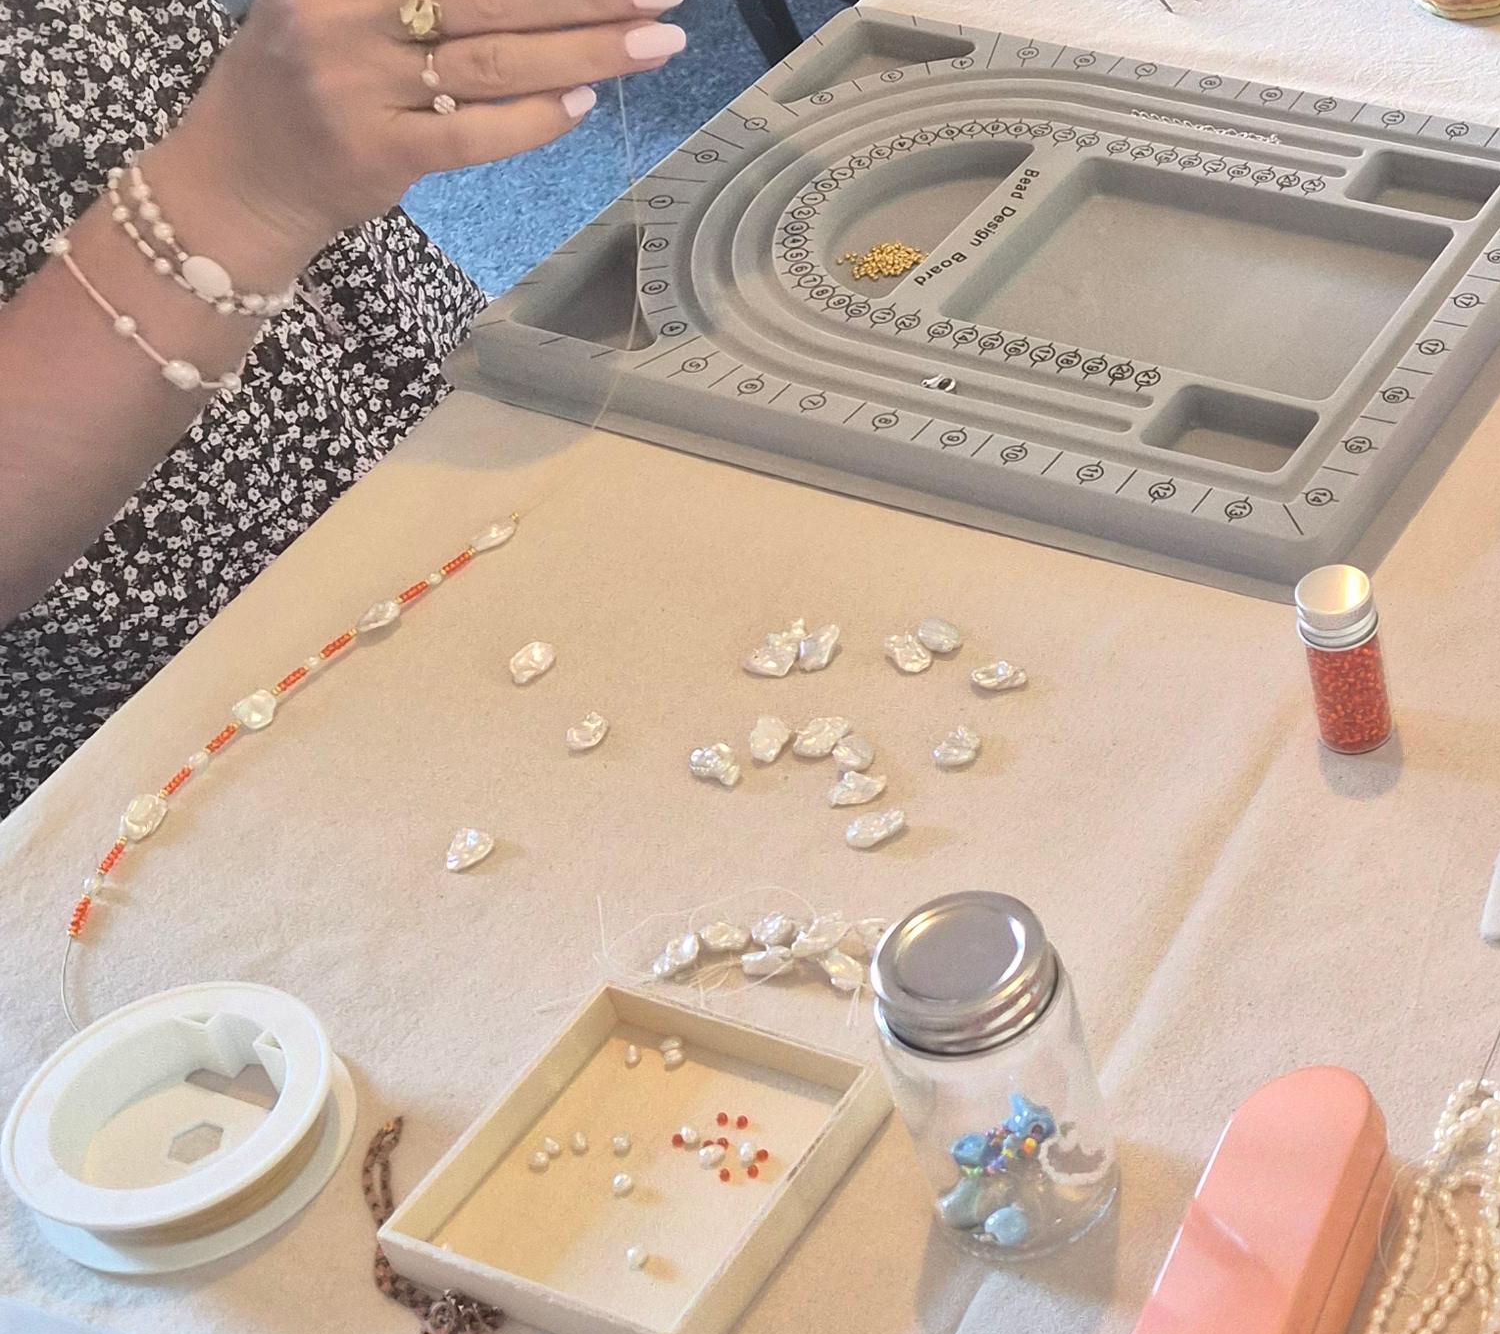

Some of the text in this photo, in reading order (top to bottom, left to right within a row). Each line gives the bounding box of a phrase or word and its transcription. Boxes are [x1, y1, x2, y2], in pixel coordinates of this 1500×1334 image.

[913, 169, 1040, 287] Bead Design Board
